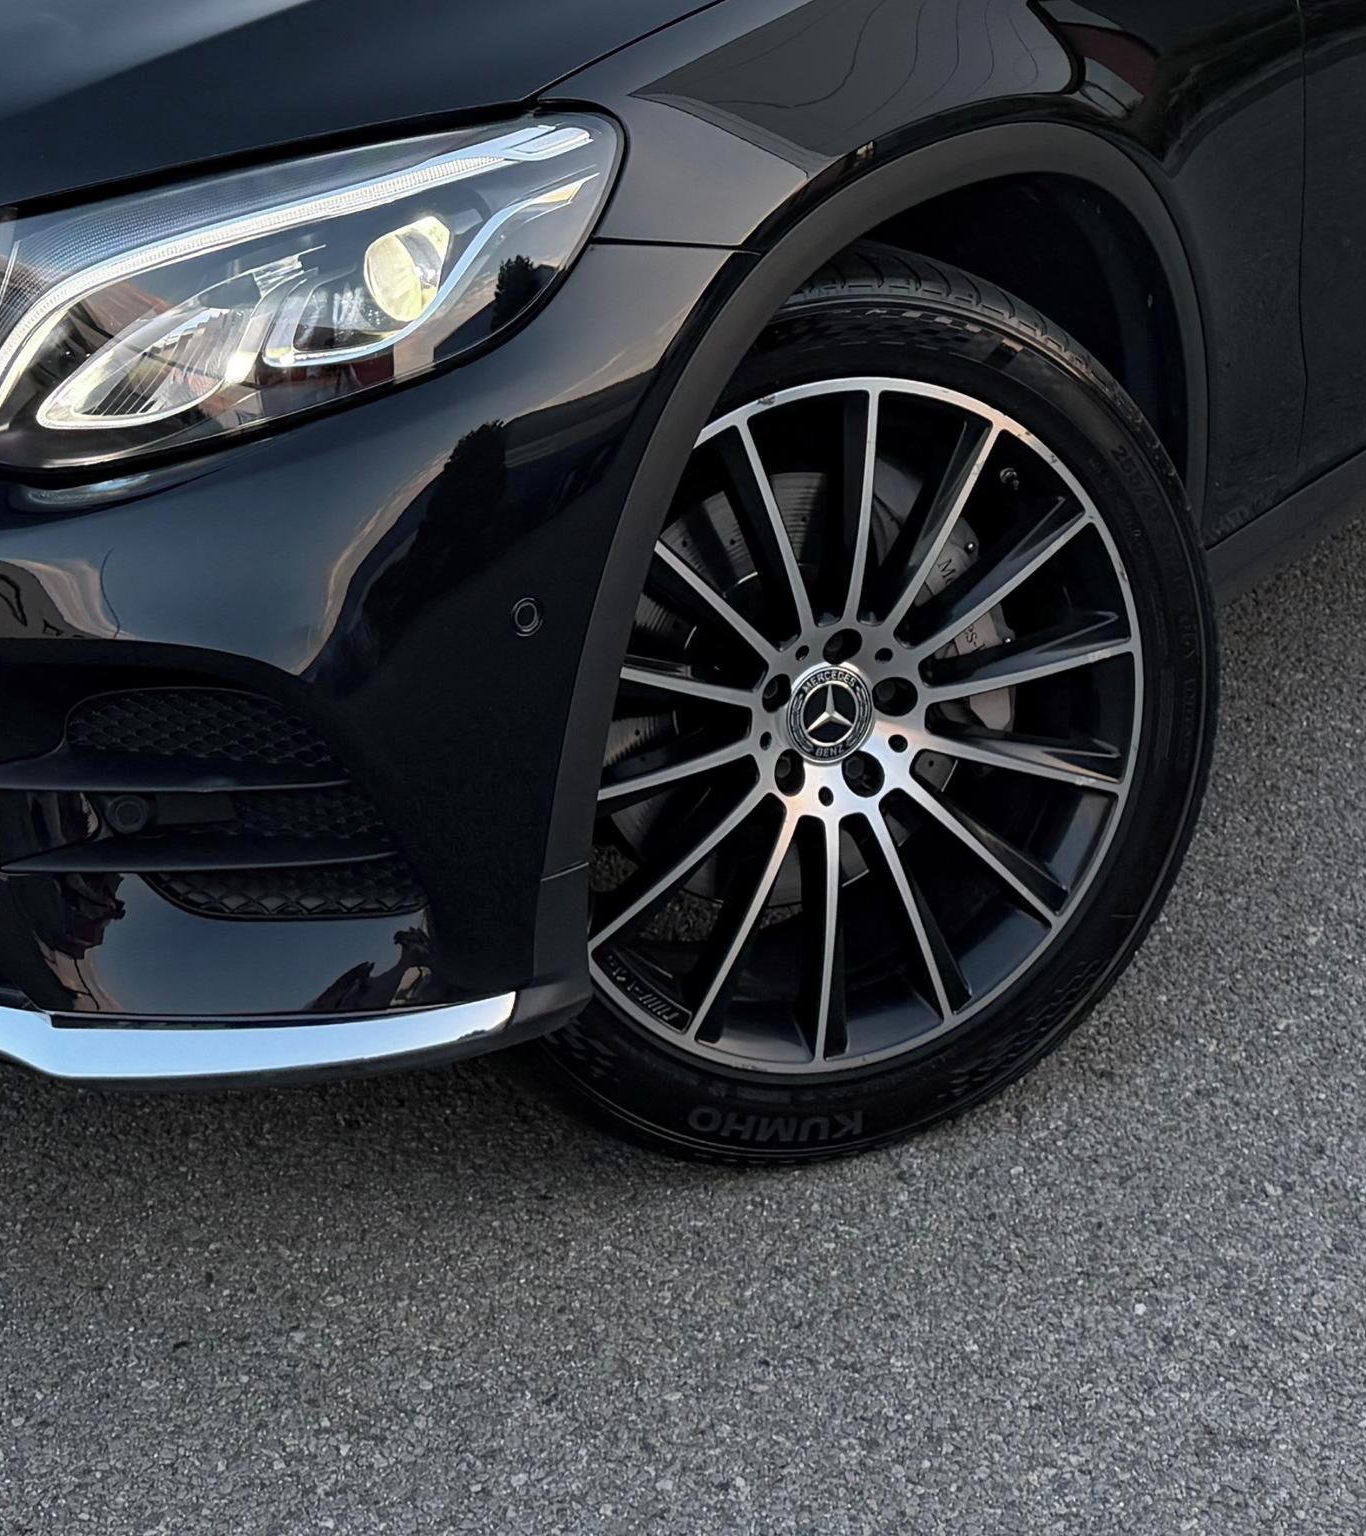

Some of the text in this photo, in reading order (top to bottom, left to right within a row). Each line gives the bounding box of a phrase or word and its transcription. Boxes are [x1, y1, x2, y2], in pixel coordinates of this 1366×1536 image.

[802, 670, 857, 694] MERCEDES
[815, 744, 846, 758] BENZ
[687, 1106, 864, 1143] KUMHO
